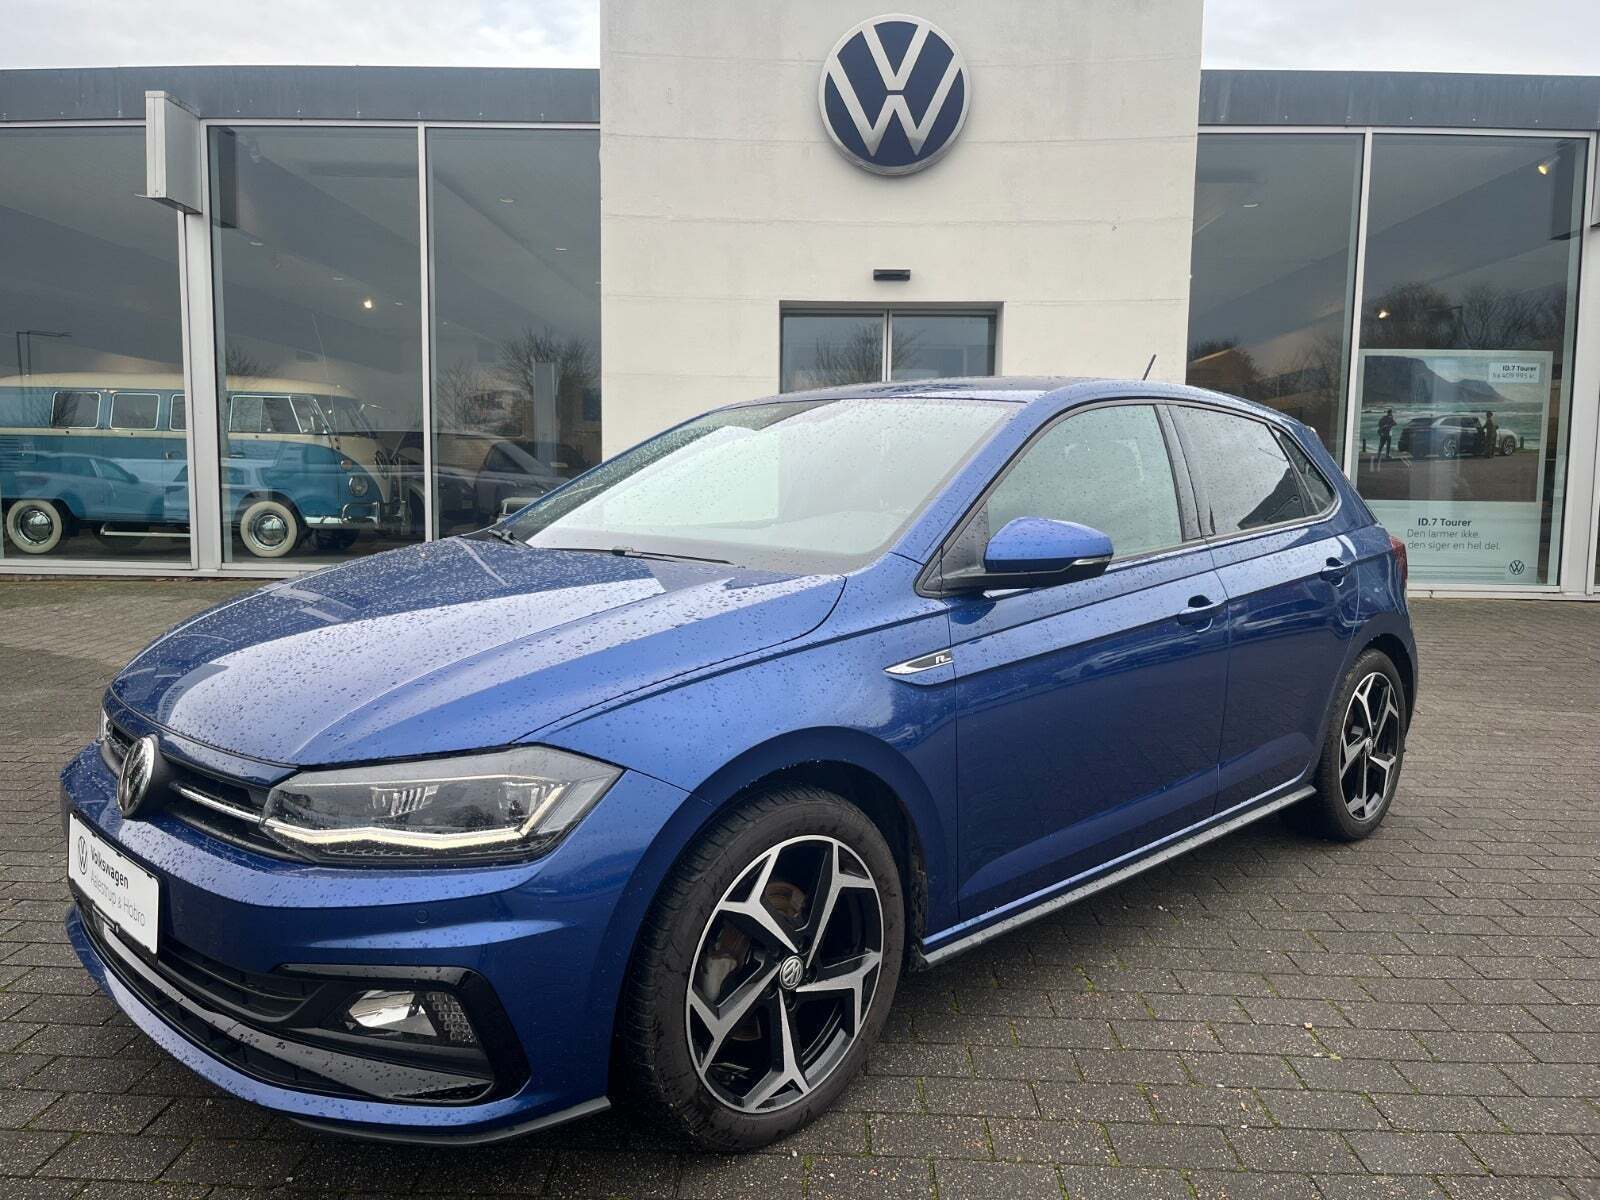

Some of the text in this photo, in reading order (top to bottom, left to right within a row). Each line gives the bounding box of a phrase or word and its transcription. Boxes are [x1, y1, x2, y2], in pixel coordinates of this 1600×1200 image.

[1417, 517, 1472, 526] ID.7 Tourer
[1407, 528, 1425, 538] Den
[1429, 528, 1458, 538] larmer
[1408, 541, 1426, 550] den
[1428, 541, 1450, 552] siger
[1453, 542, 1465, 550] en
[1467, 541, 1482, 550] hel
[90, 843, 129, 889] Volkswagen
